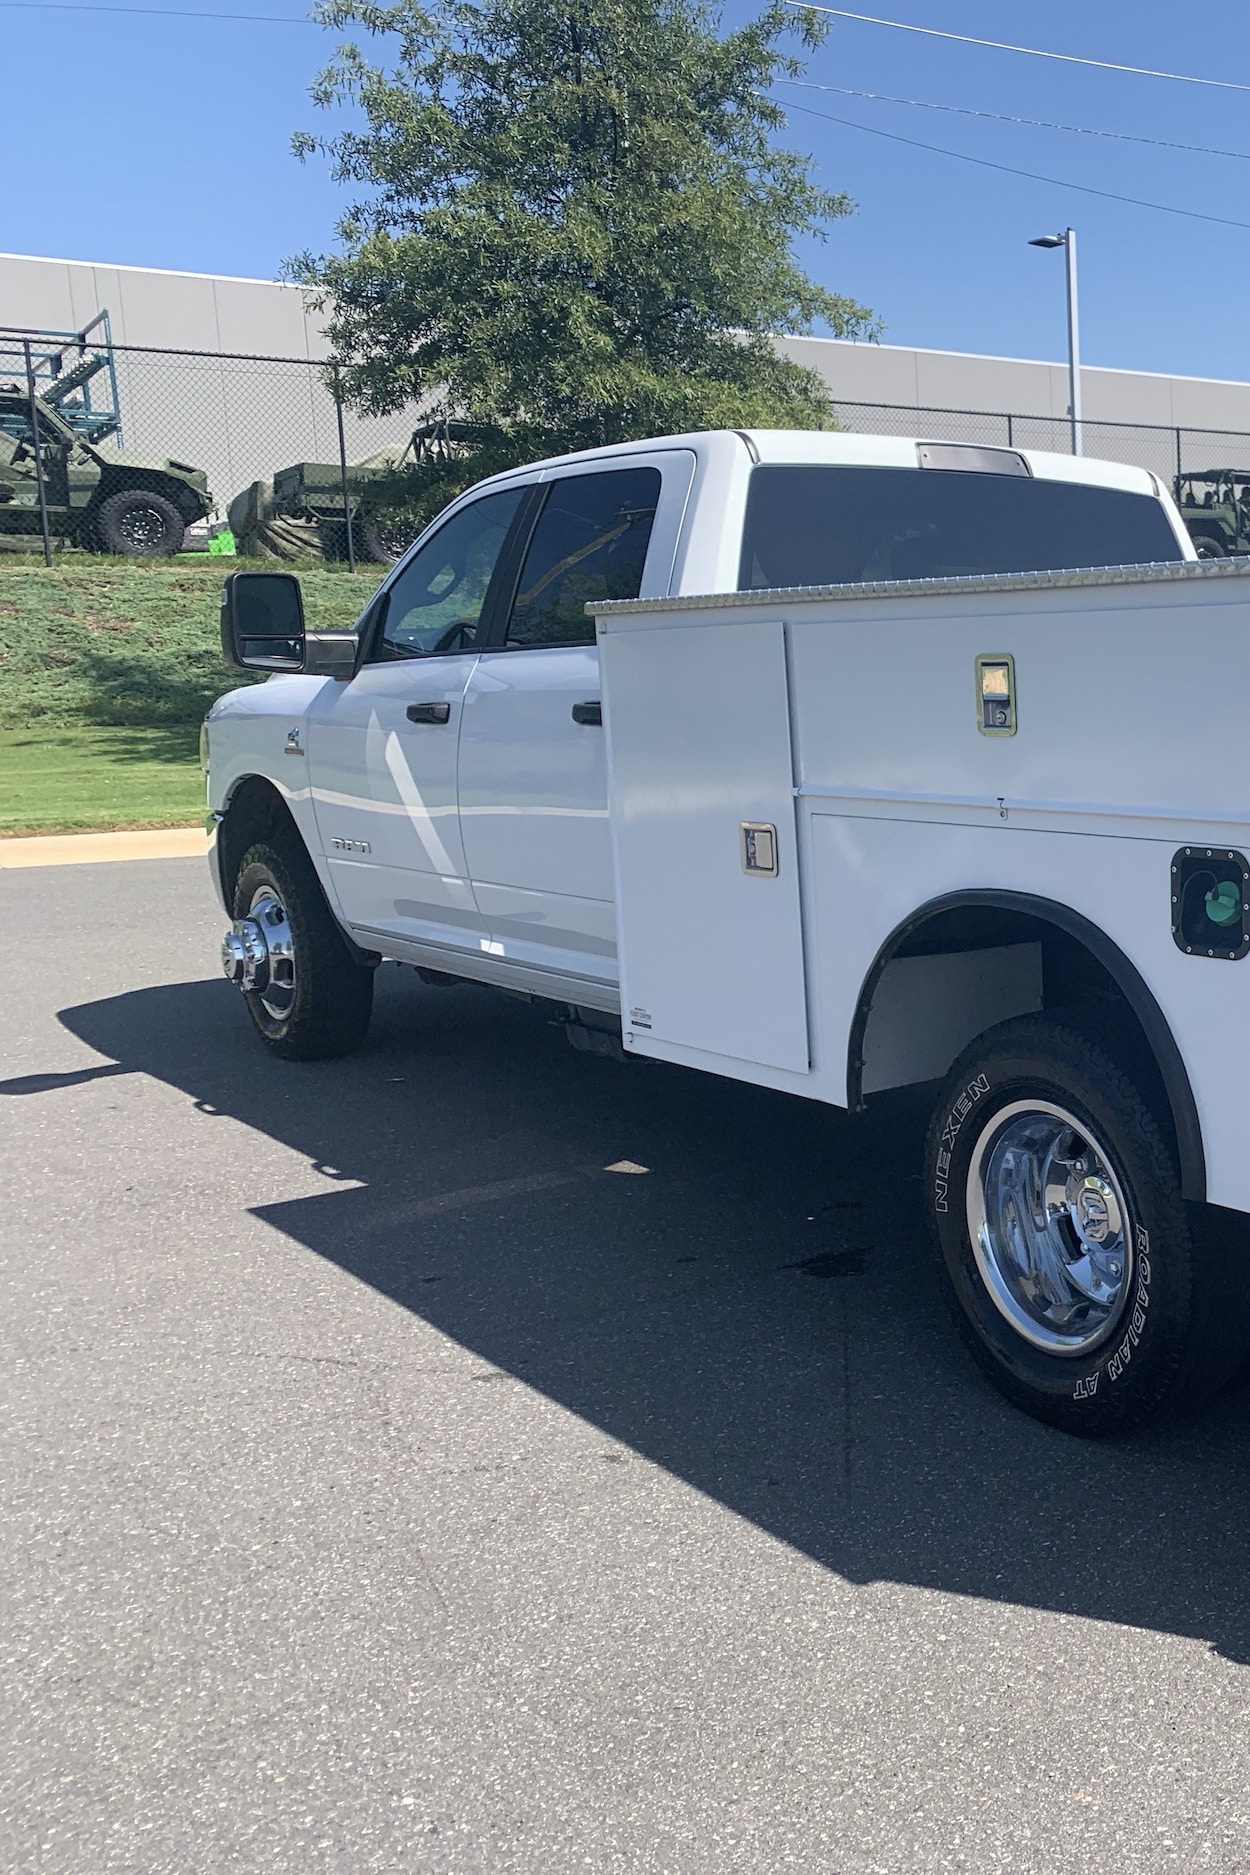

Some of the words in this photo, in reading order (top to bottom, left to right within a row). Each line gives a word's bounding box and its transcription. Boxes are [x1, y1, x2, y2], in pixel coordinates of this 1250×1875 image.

[935, 1073, 991, 1213] NEXEN
[1111, 1224, 1153, 1382] ROADIAN
[1072, 1372, 1099, 1400] AT
